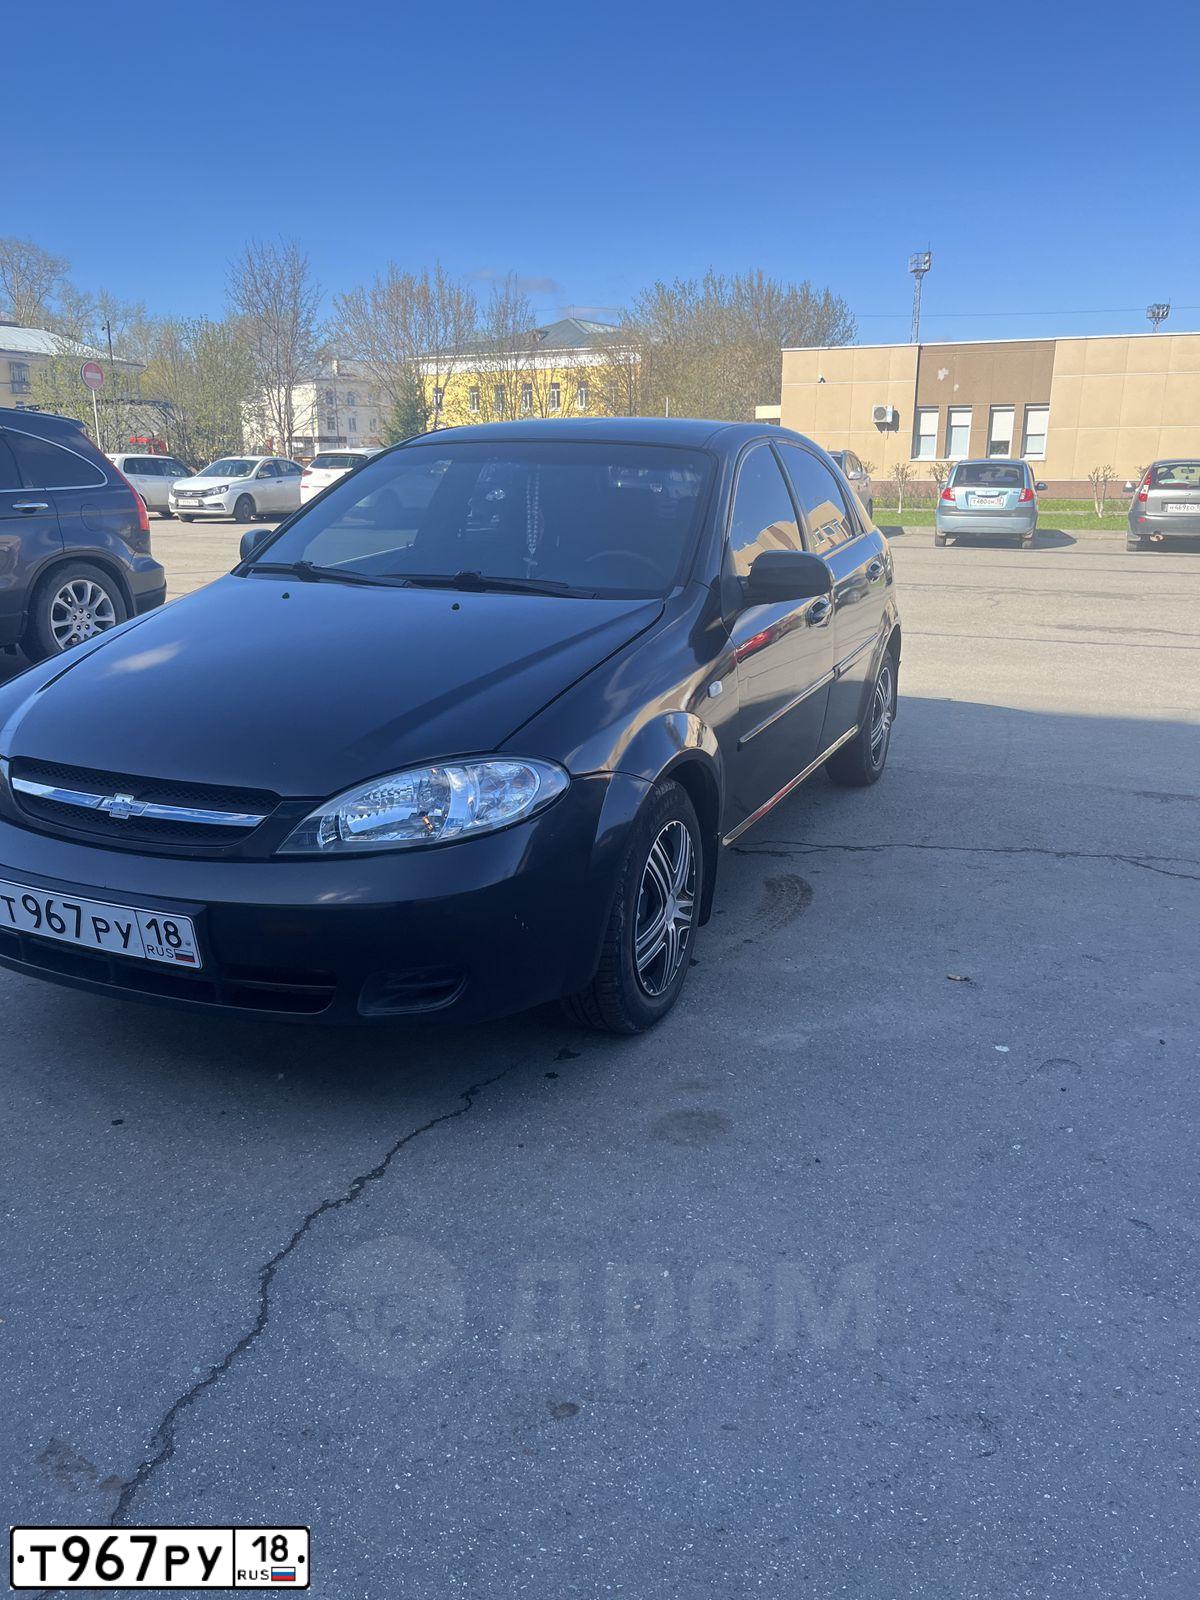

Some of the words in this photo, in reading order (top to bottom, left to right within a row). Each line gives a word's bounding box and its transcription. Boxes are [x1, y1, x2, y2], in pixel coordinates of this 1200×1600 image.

[0, 893, 132, 949] Т967РУ
[145, 918, 182, 948] 18
[146, 944, 175, 959] RUS
